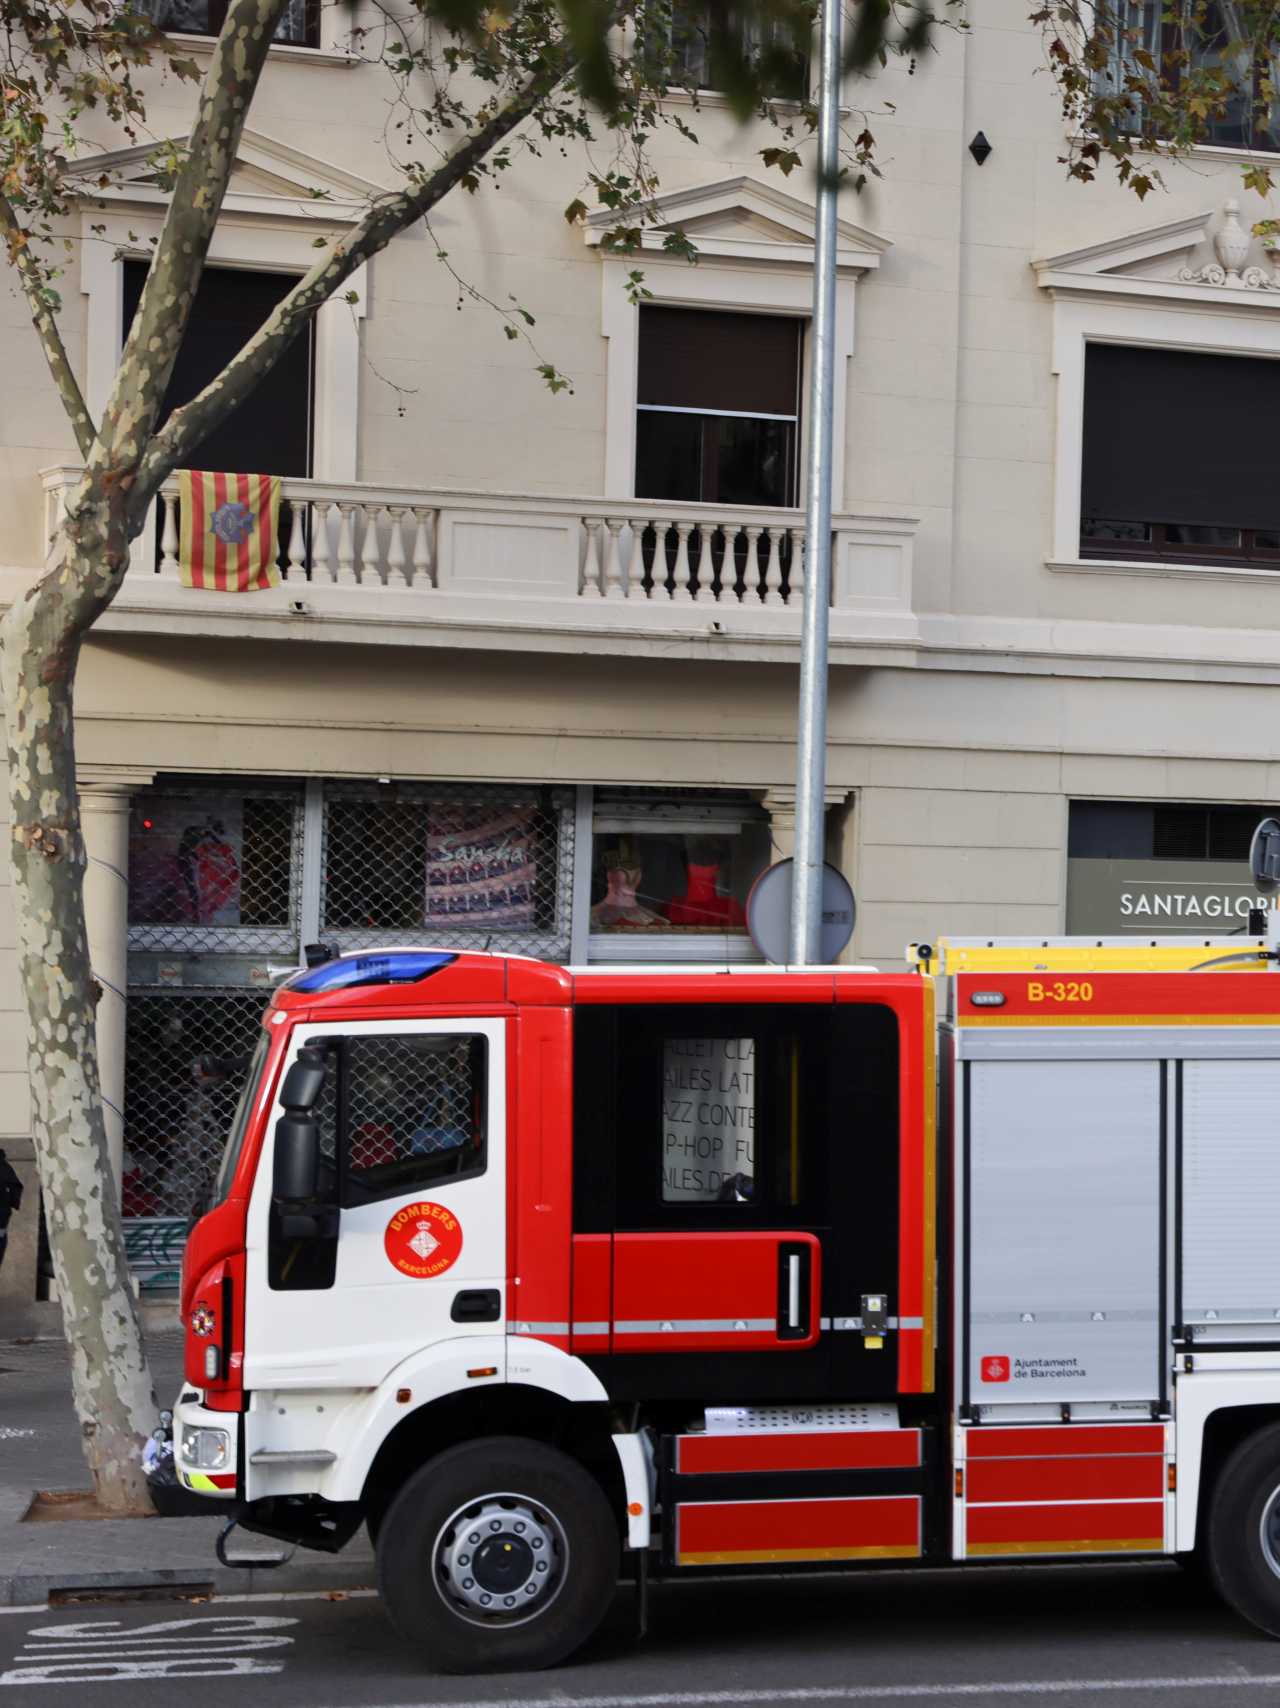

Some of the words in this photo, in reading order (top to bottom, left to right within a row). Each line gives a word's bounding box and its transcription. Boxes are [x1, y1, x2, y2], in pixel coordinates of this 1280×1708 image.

[1028, 982, 1093, 1002] B-320
[390, 1204, 456, 1231] BOMBERS
[398, 1258, 449, 1274] BARCELONA
[1014, 1358, 1077, 1369] Ajuntament
[1014, 1370, 1027, 1378] de
[1031, 1369, 1087, 1378] Barcelona
